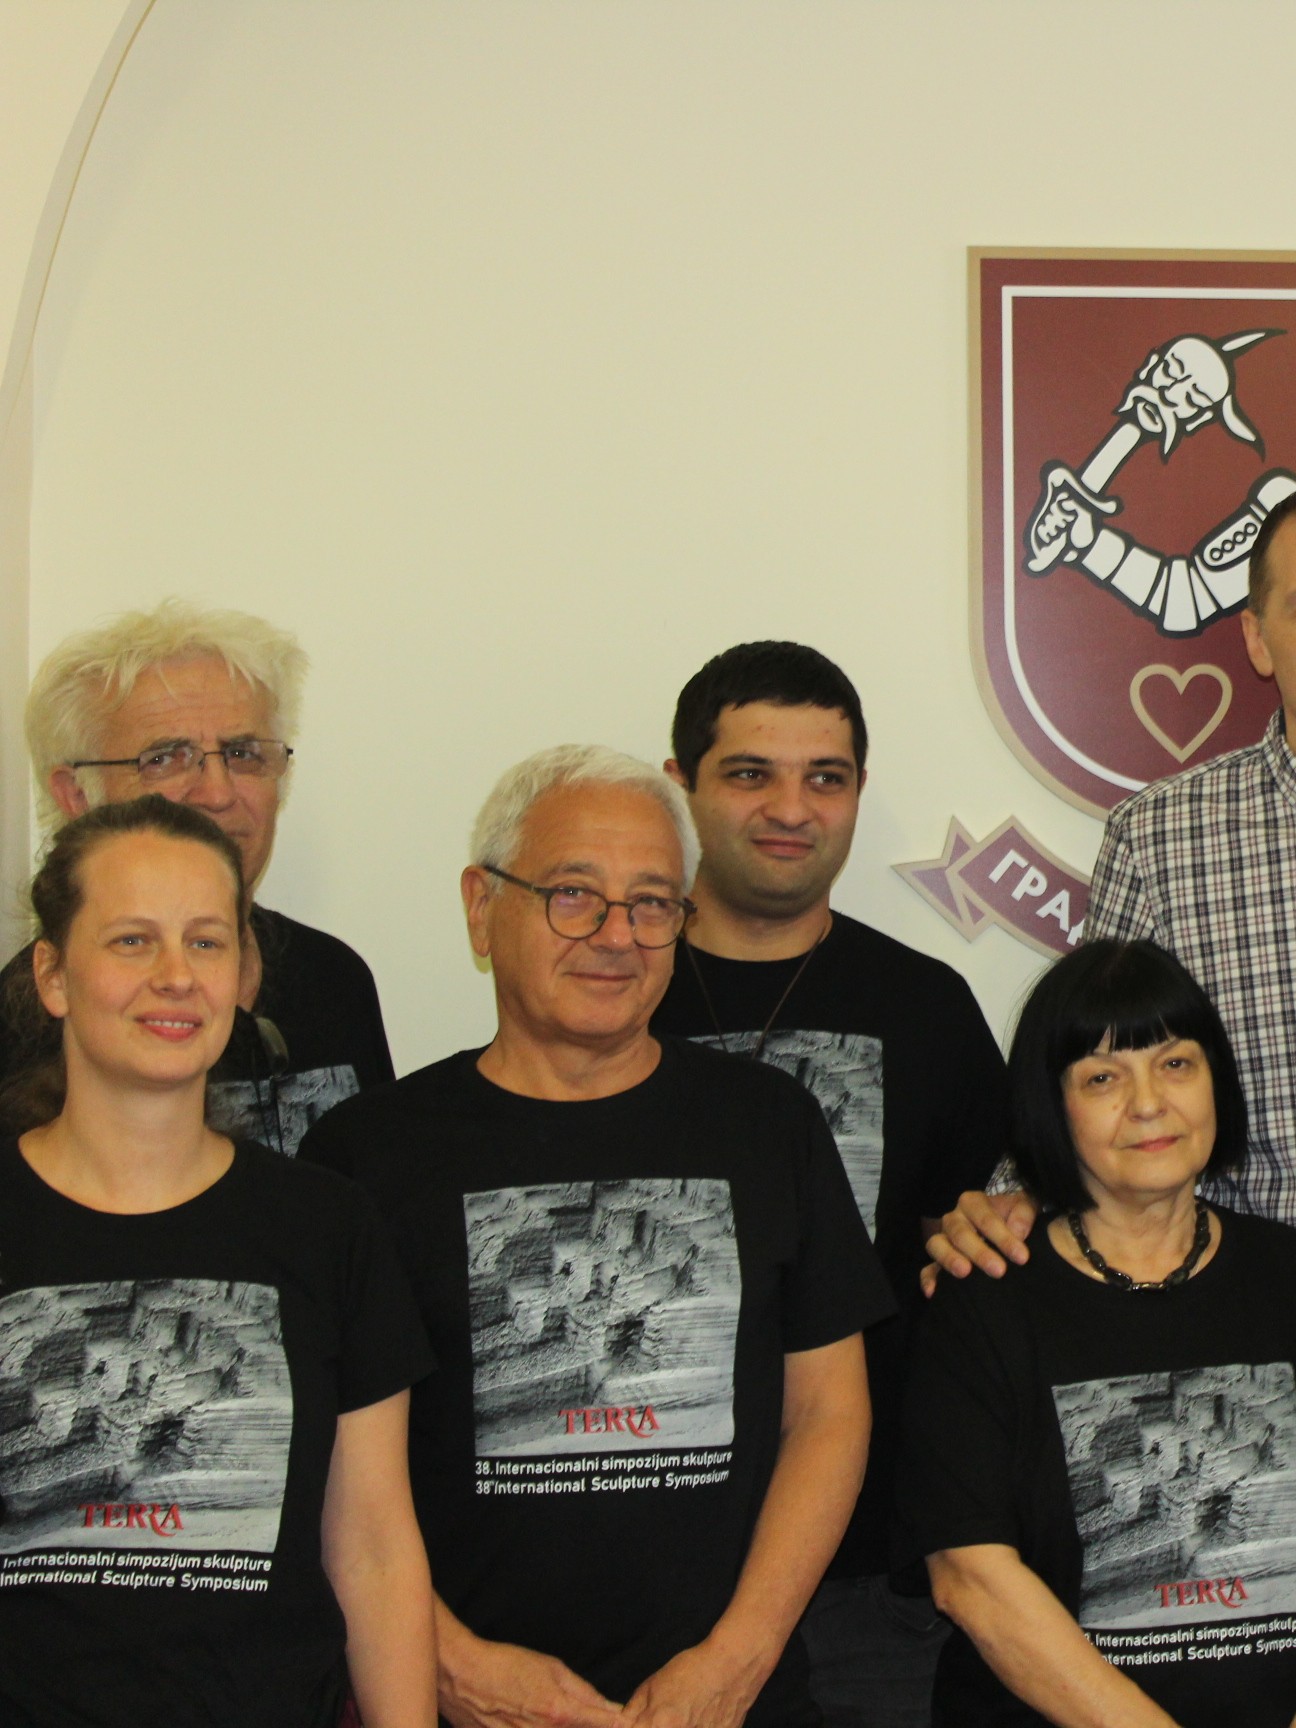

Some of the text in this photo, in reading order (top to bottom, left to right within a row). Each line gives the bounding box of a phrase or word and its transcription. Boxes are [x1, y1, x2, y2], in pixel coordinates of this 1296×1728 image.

[558, 1405, 661, 1438] TERRA
[475, 1450, 733, 1475] 38. Internacionalni simpozijum skulpture
[494, 1476, 586, 1495] International
[591, 1475, 660, 1492] Sculpture
[665, 1468, 729, 1489] Symposium
[79, 1503, 184, 1537] TERRA
[3, 1551, 272, 1572] Internacionalni simpozijum skulpture
[0, 1571, 268, 1592] International Sculpture Symposium
[1154, 1576, 1249, 1609] TERRA
[1095, 1627, 1194, 1648] Internacionalni
[1196, 1622, 1268, 1642] simpozijum
[1101, 1649, 1183, 1666] ternational
[1187, 1643, 1252, 1661] Sculpture
